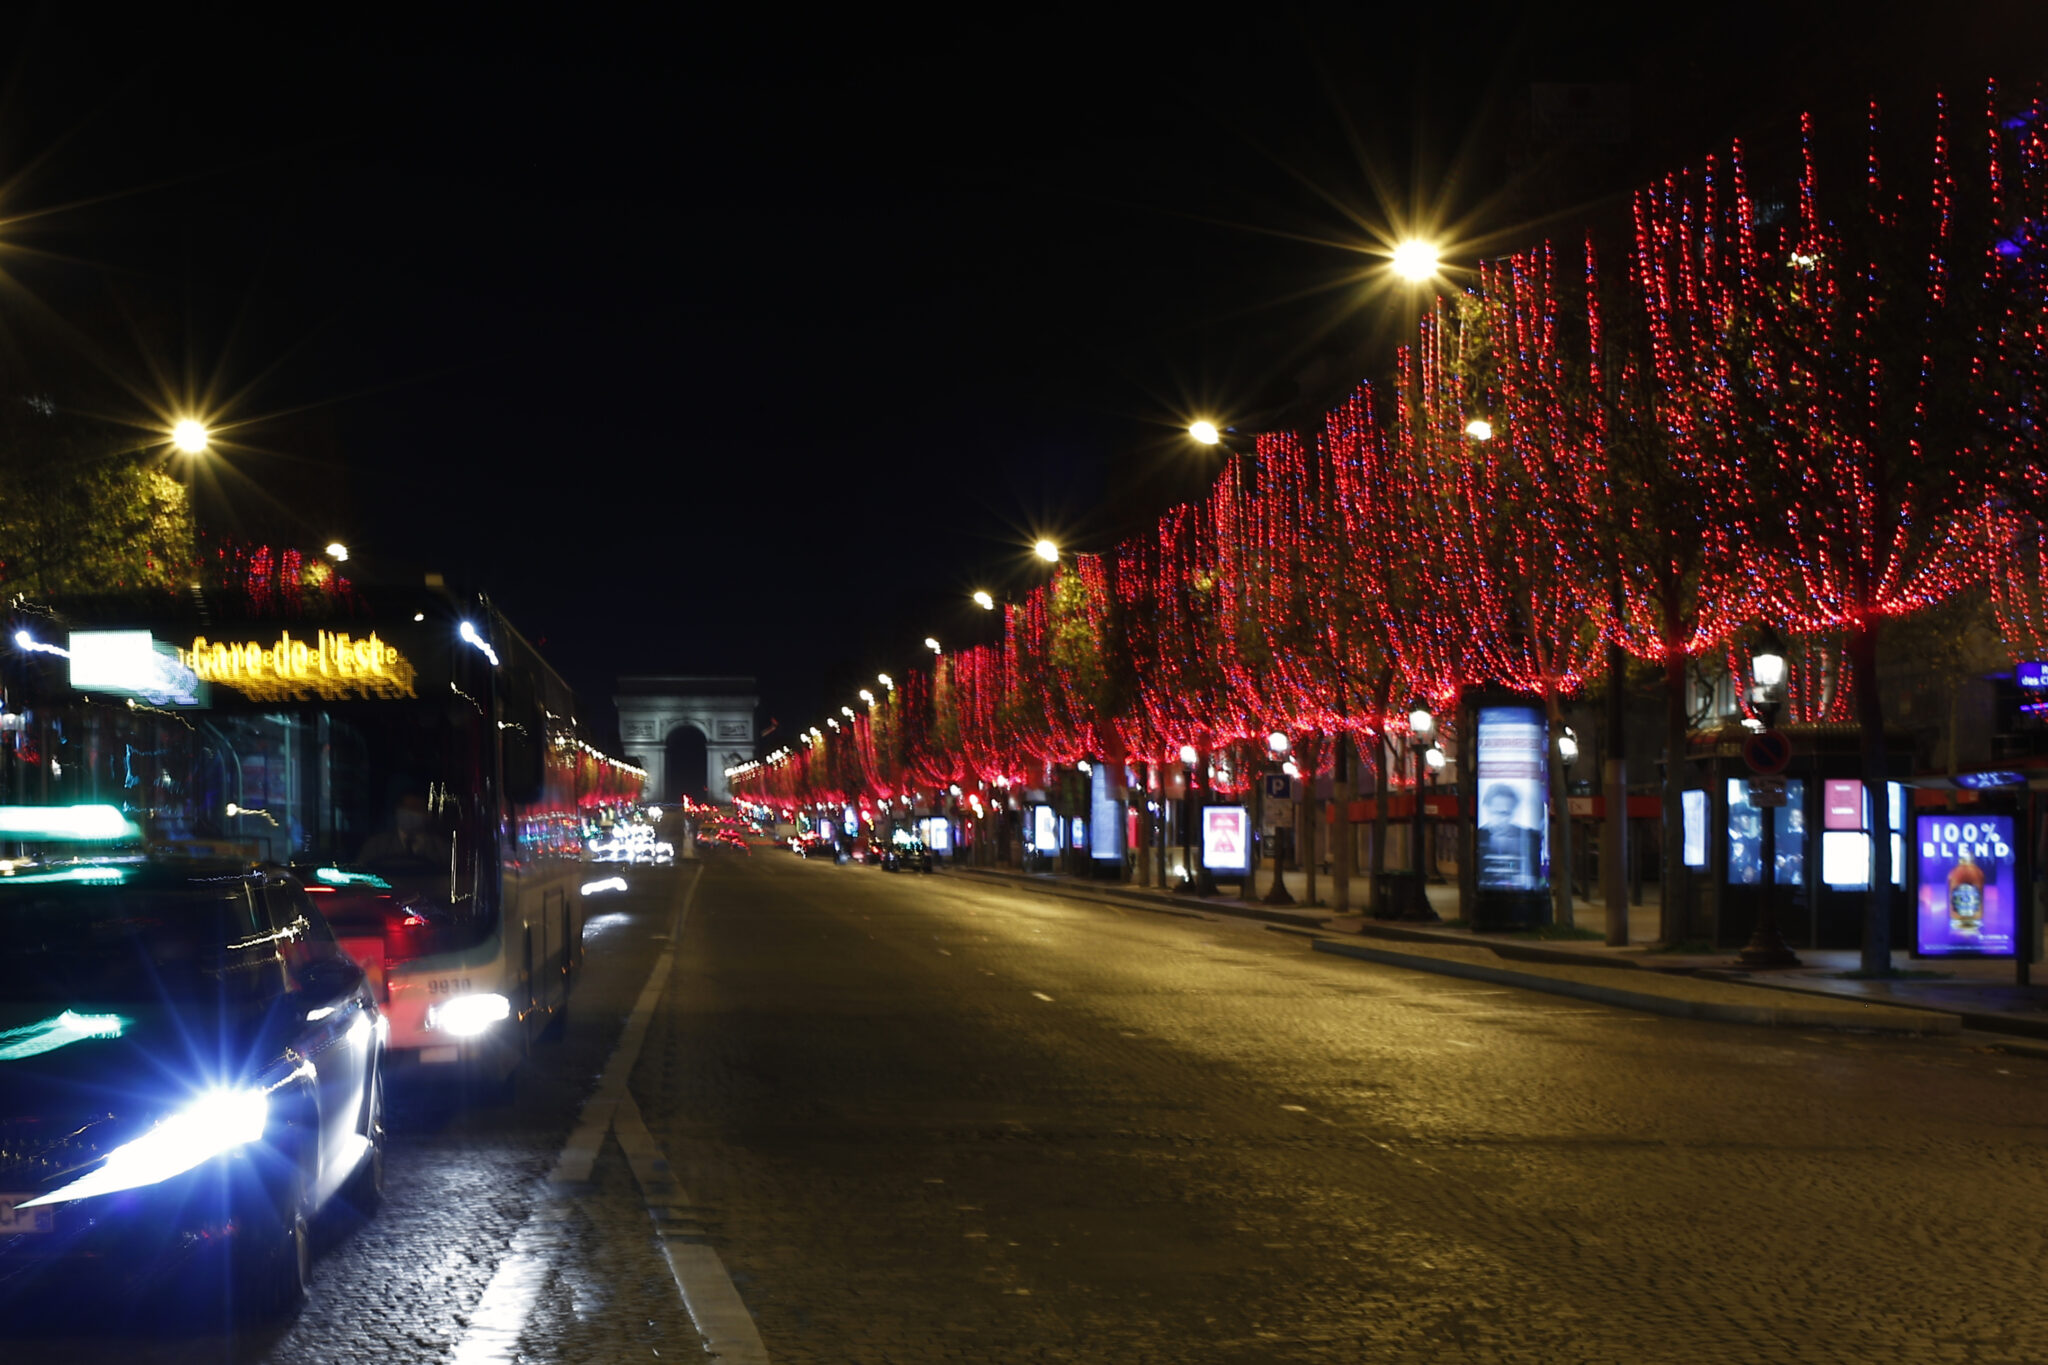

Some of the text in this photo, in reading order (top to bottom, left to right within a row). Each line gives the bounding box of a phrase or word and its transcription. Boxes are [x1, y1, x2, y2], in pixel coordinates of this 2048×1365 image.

[193, 635, 262, 680] Gare
[273, 630, 309, 679] de
[318, 629, 388, 678] l'Est
[1932, 822, 2000, 843] 100%
[1922, 842, 2010, 858] BLEND
